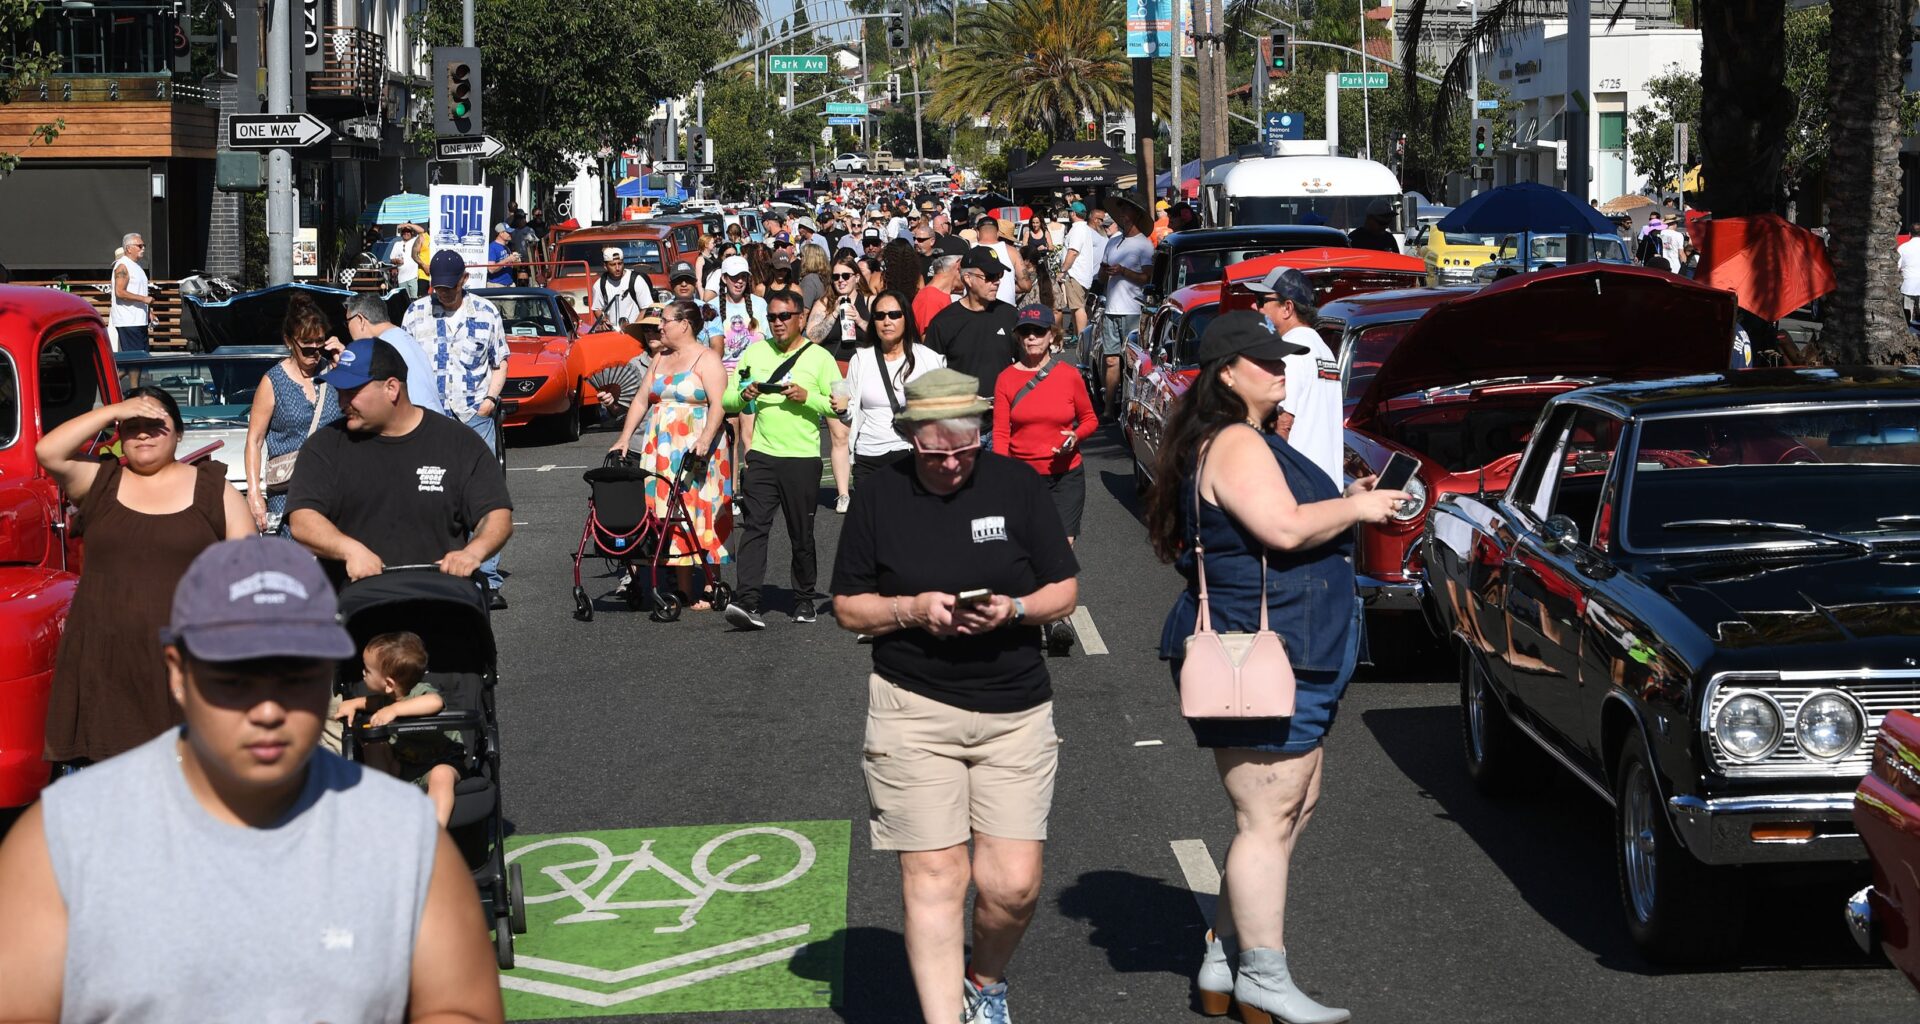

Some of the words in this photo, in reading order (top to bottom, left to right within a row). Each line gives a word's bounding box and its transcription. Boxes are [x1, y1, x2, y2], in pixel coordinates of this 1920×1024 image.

[774, 60, 798, 69] Park
[805, 60, 823, 69] Ave
[1599, 79, 1621, 89] 4725
[240, 125, 266, 137] ONE
[270, 124, 297, 136] WAY
[443, 144, 463, 154] ONE
[464, 142, 483, 152] WAY
[440, 195, 483, 243] SCC
